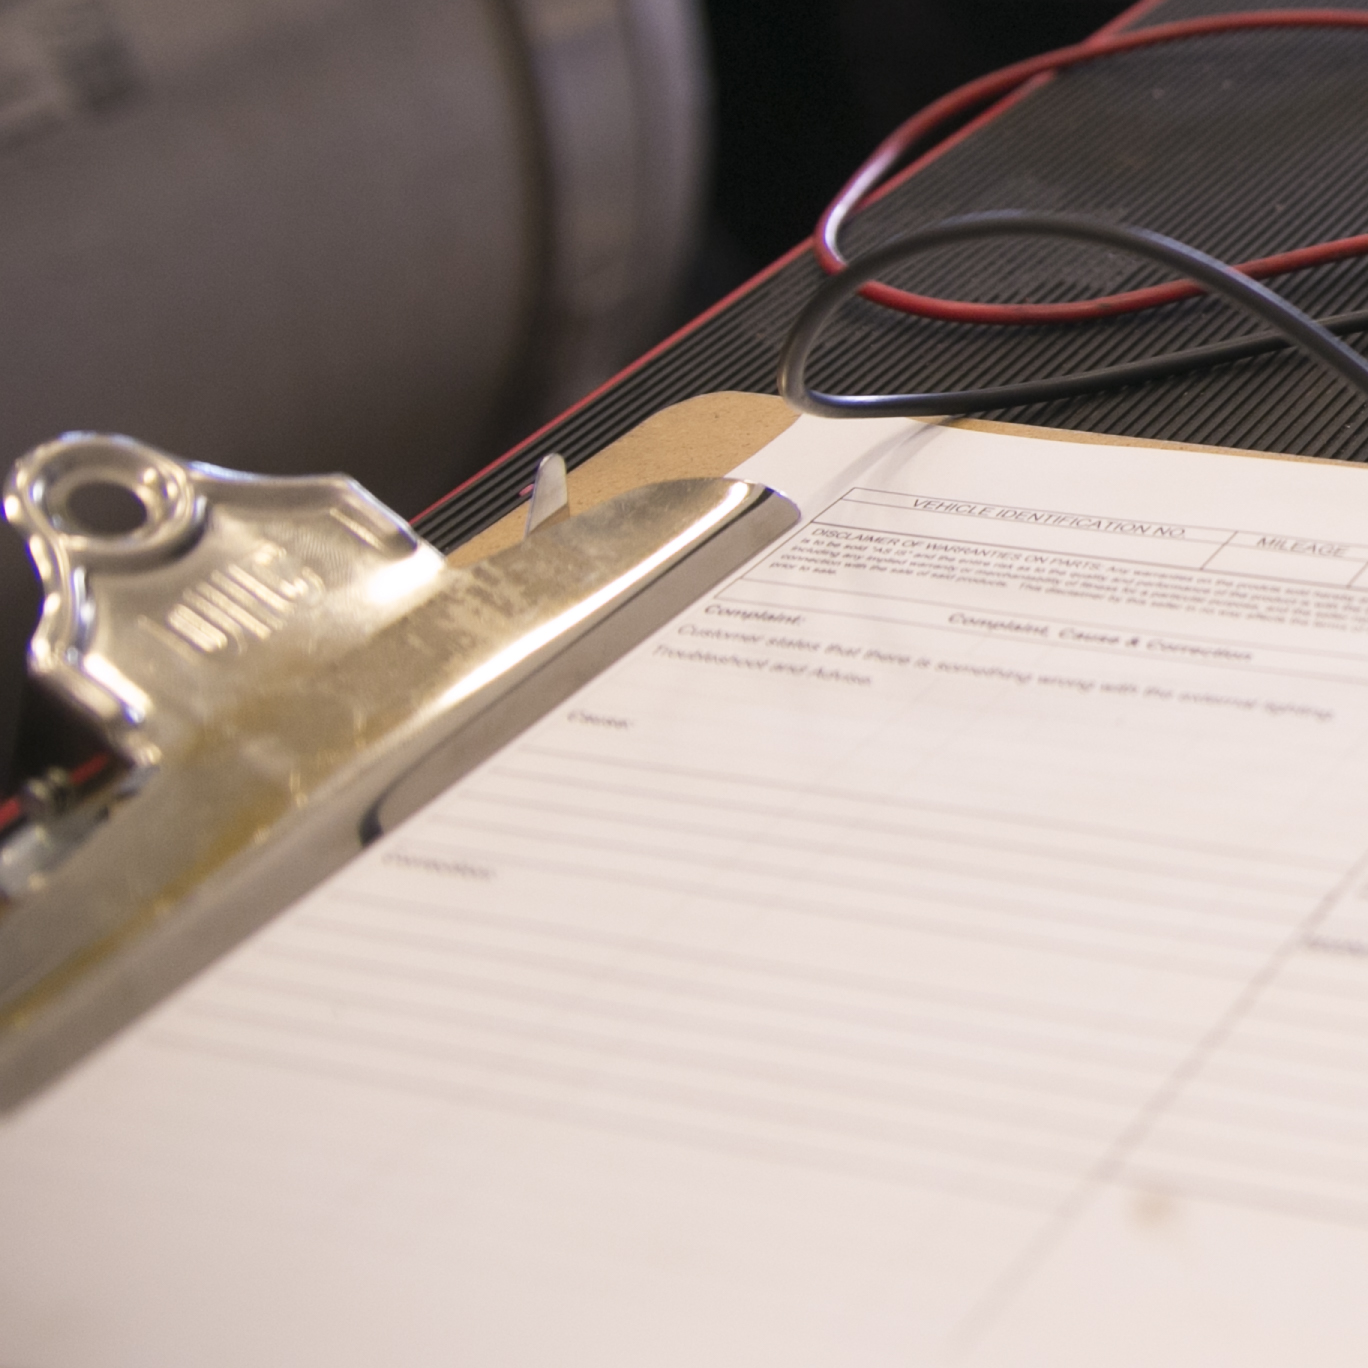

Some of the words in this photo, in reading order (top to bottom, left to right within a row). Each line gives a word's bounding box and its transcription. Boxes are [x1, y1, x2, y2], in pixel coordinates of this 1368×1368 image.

[912, 498, 991, 517] VEHICLE
[996, 508, 1151, 535] IDENTIFICATION
[1152, 525, 1185, 539] NO.
[811, 528, 900, 547] DISCLAIMER
[901, 539, 922, 547] OF
[925, 541, 1022, 561] WARRANTIES
[1024, 553, 1048, 563] ON
[1255, 536, 1349, 558] MILEAGE
